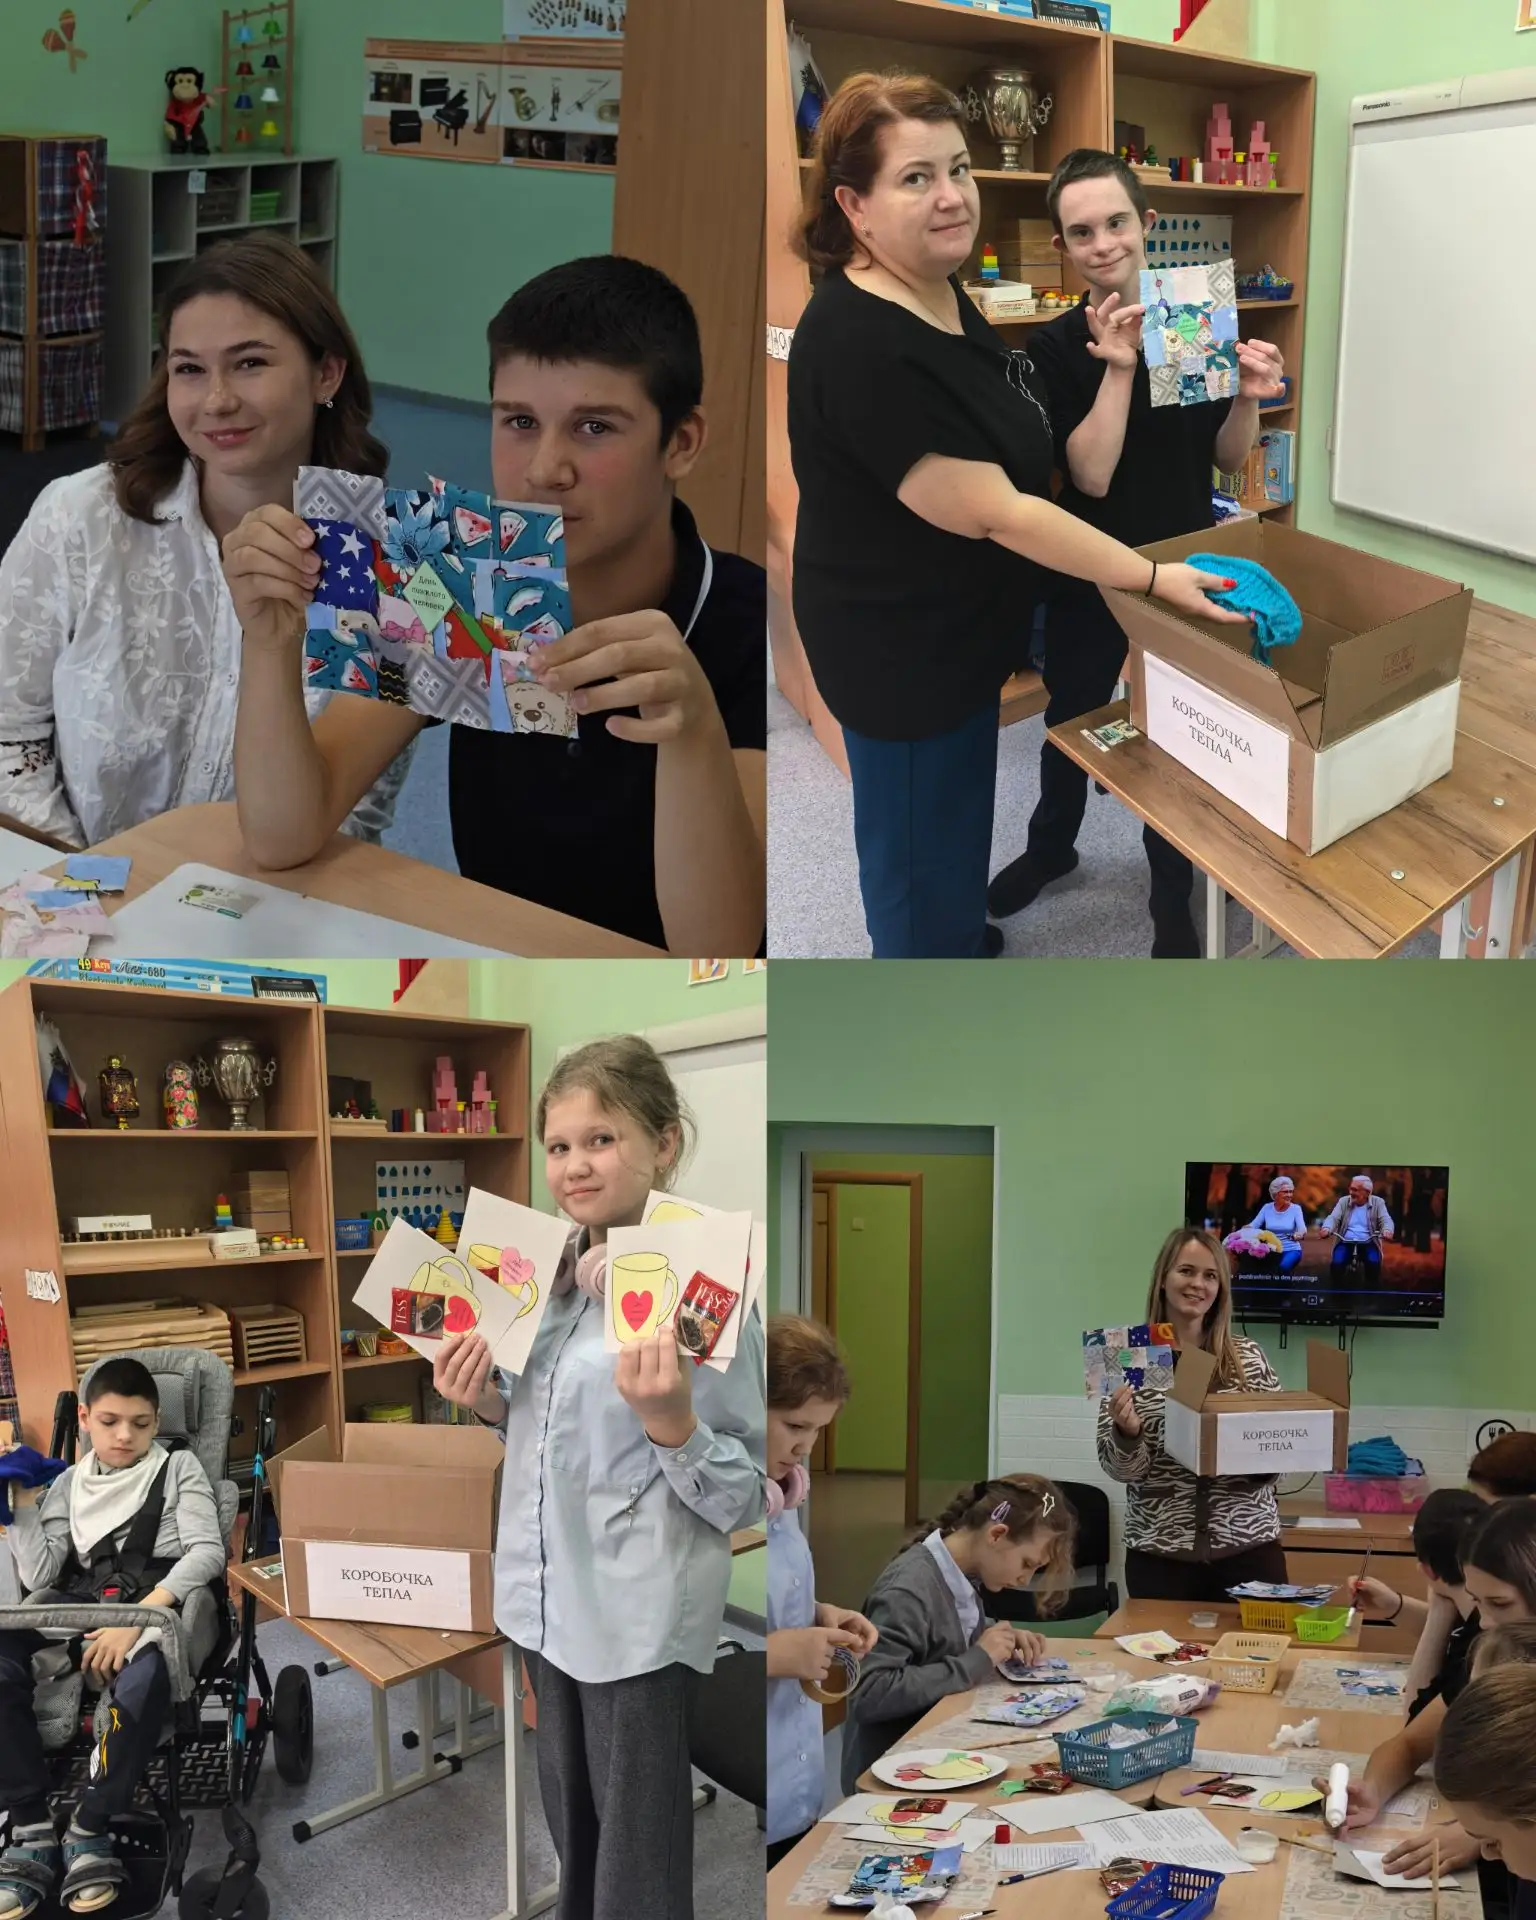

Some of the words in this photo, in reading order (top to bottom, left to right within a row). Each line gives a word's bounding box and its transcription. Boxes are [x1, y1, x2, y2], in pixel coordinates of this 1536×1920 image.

[1362, 101, 1391, 111] Panasonic
[418, 575, 437, 586] День
[1171, 695, 1253, 757] КОРОБОЧКА
[1188, 725, 1233, 764] ТЕПЛА
[78, 958, 92, 971] 49
[94, 959, 112, 973] Keys
[694, 1282, 722, 1310] TESS
[395, 1299, 408, 1326] TESS
[1242, 1428, 1309, 1441] КОРОБОЧКА
[1258, 1441, 1293, 1452] ТЕПЛА
[340, 1568, 434, 1586] КОРОБОЧКА
[362, 1586, 413, 1601] ТЕПЛА
